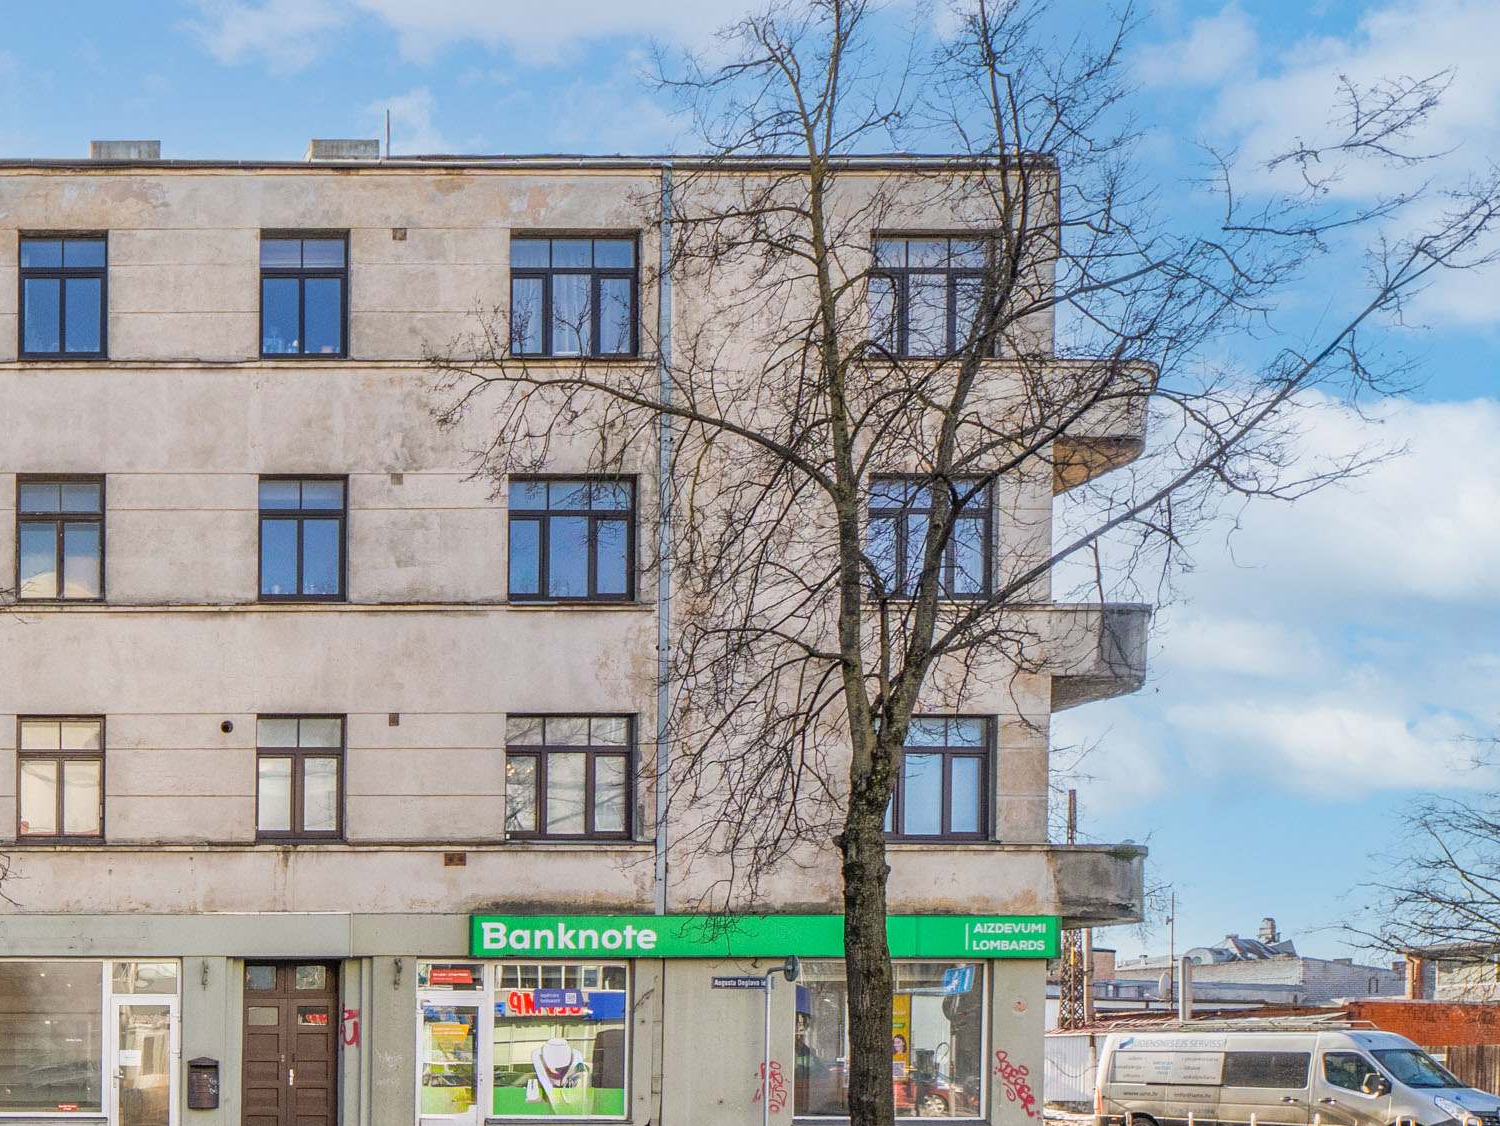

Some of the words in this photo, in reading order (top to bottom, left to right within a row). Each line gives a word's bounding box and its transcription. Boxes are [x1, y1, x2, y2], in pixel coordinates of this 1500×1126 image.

[973, 923, 1046, 933] AIZDEVUMI
[481, 921, 658, 950] Banknote
[972, 940, 1045, 950] LOMBARDS
[714, 979, 736, 987] Augusta
[737, 979, 759, 987] Deglava
